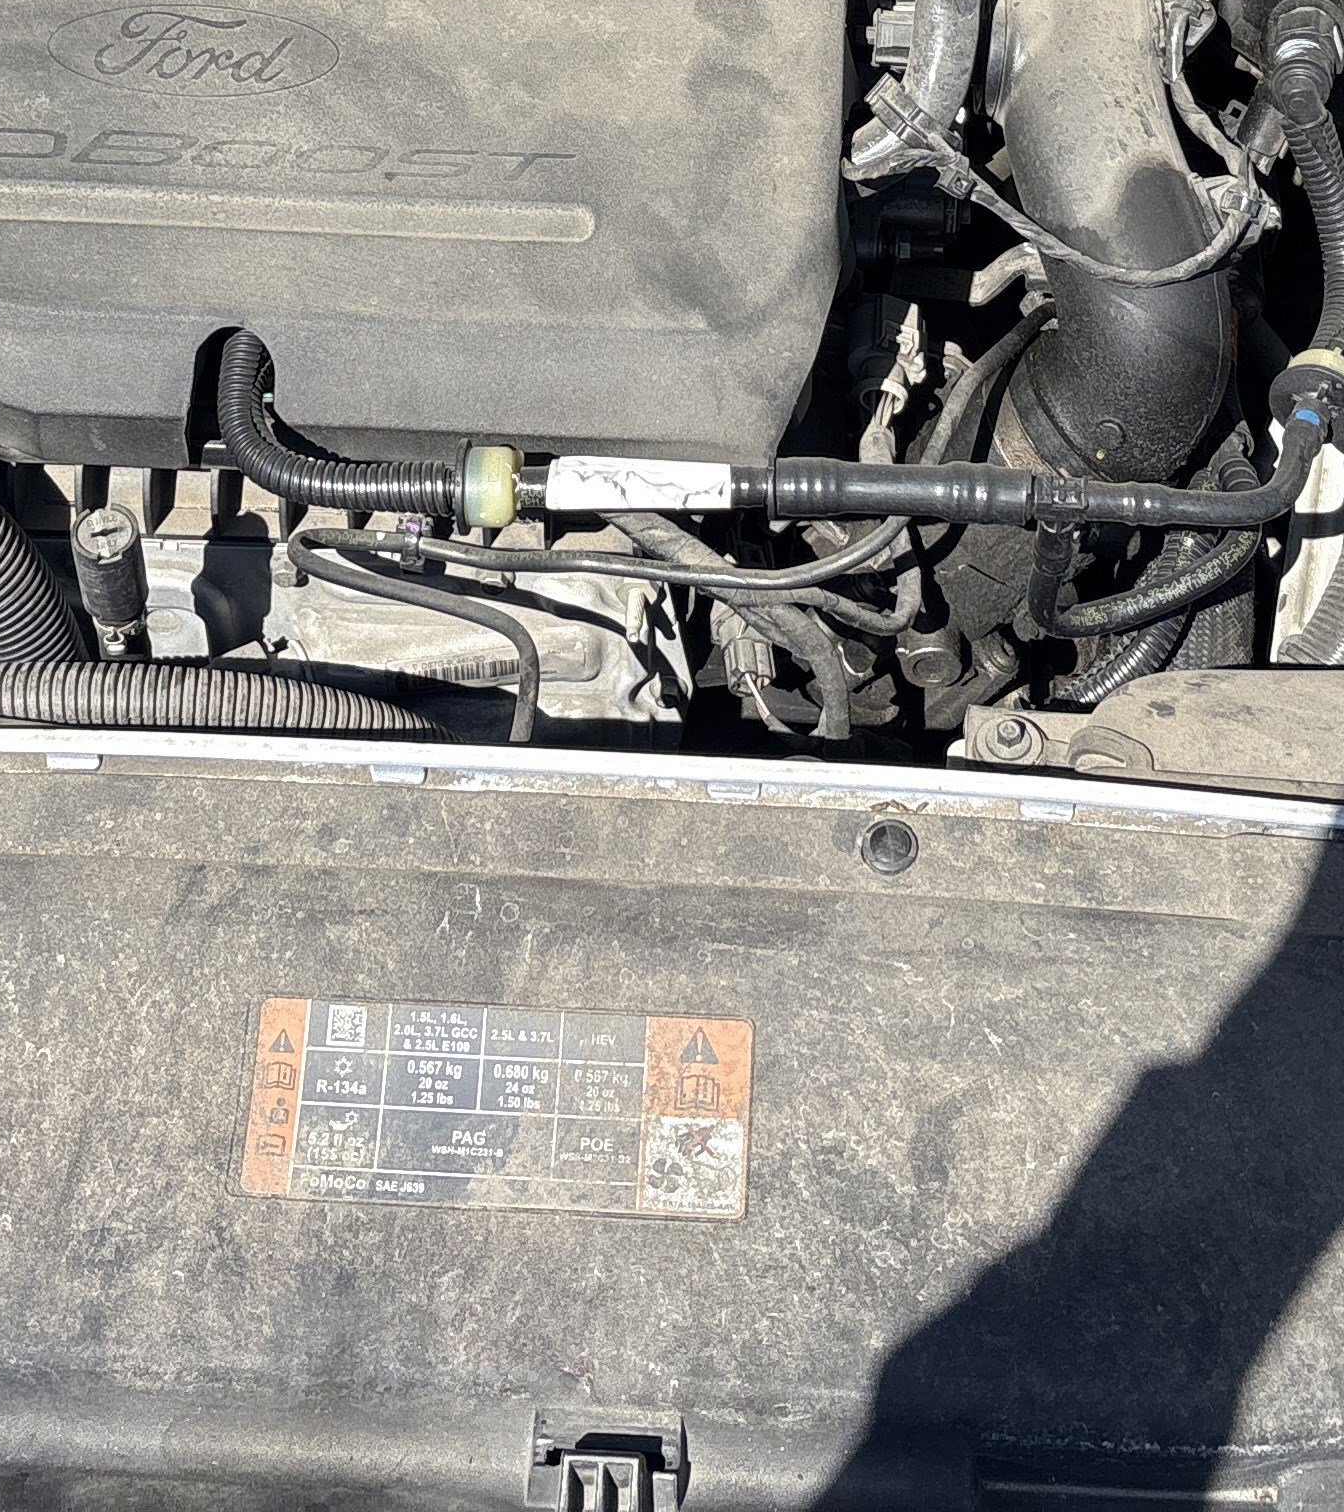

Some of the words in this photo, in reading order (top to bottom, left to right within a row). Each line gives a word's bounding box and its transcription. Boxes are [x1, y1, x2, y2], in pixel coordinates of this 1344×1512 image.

[94, 10, 293, 86] Ford
[424, 1025, 448, 1038] 3.7L
[451, 1027, 478, 1039] GCC
[491, 1029, 515, 1042] 2.5L
[518, 1030, 527, 1042] &
[530, 1031, 554, 1043] 3.7L
[403, 1039, 412, 1050] &
[415, 1039, 439, 1051] 2.5L
[407, 1060, 442, 1075] 0.567
[446, 1061, 463, 1079] kg
[493, 1064, 528, 1080] 0.680
[532, 1066, 549, 1084] kg
[316, 1079, 367, 1095] R-134a
[418, 1077, 432, 1089] 20
[434, 1079, 449, 1090] oz
[505, 1082, 519, 1094] 24
[522, 1084, 535, 1095] oz
[411, 1092, 433, 1104] 1.25
[436, 1092, 454, 1105] lbs
[586, 1085, 599, 1097] 20
[601, 1087, 615, 1098] oz
[498, 1096, 521, 1108] 1.50
[523, 1097, 540, 1110] lbs
[451, 1129, 487, 1145] PAG
[580, 1137, 615, 1152] POE
[376, 1179, 398, 1192] SAE
